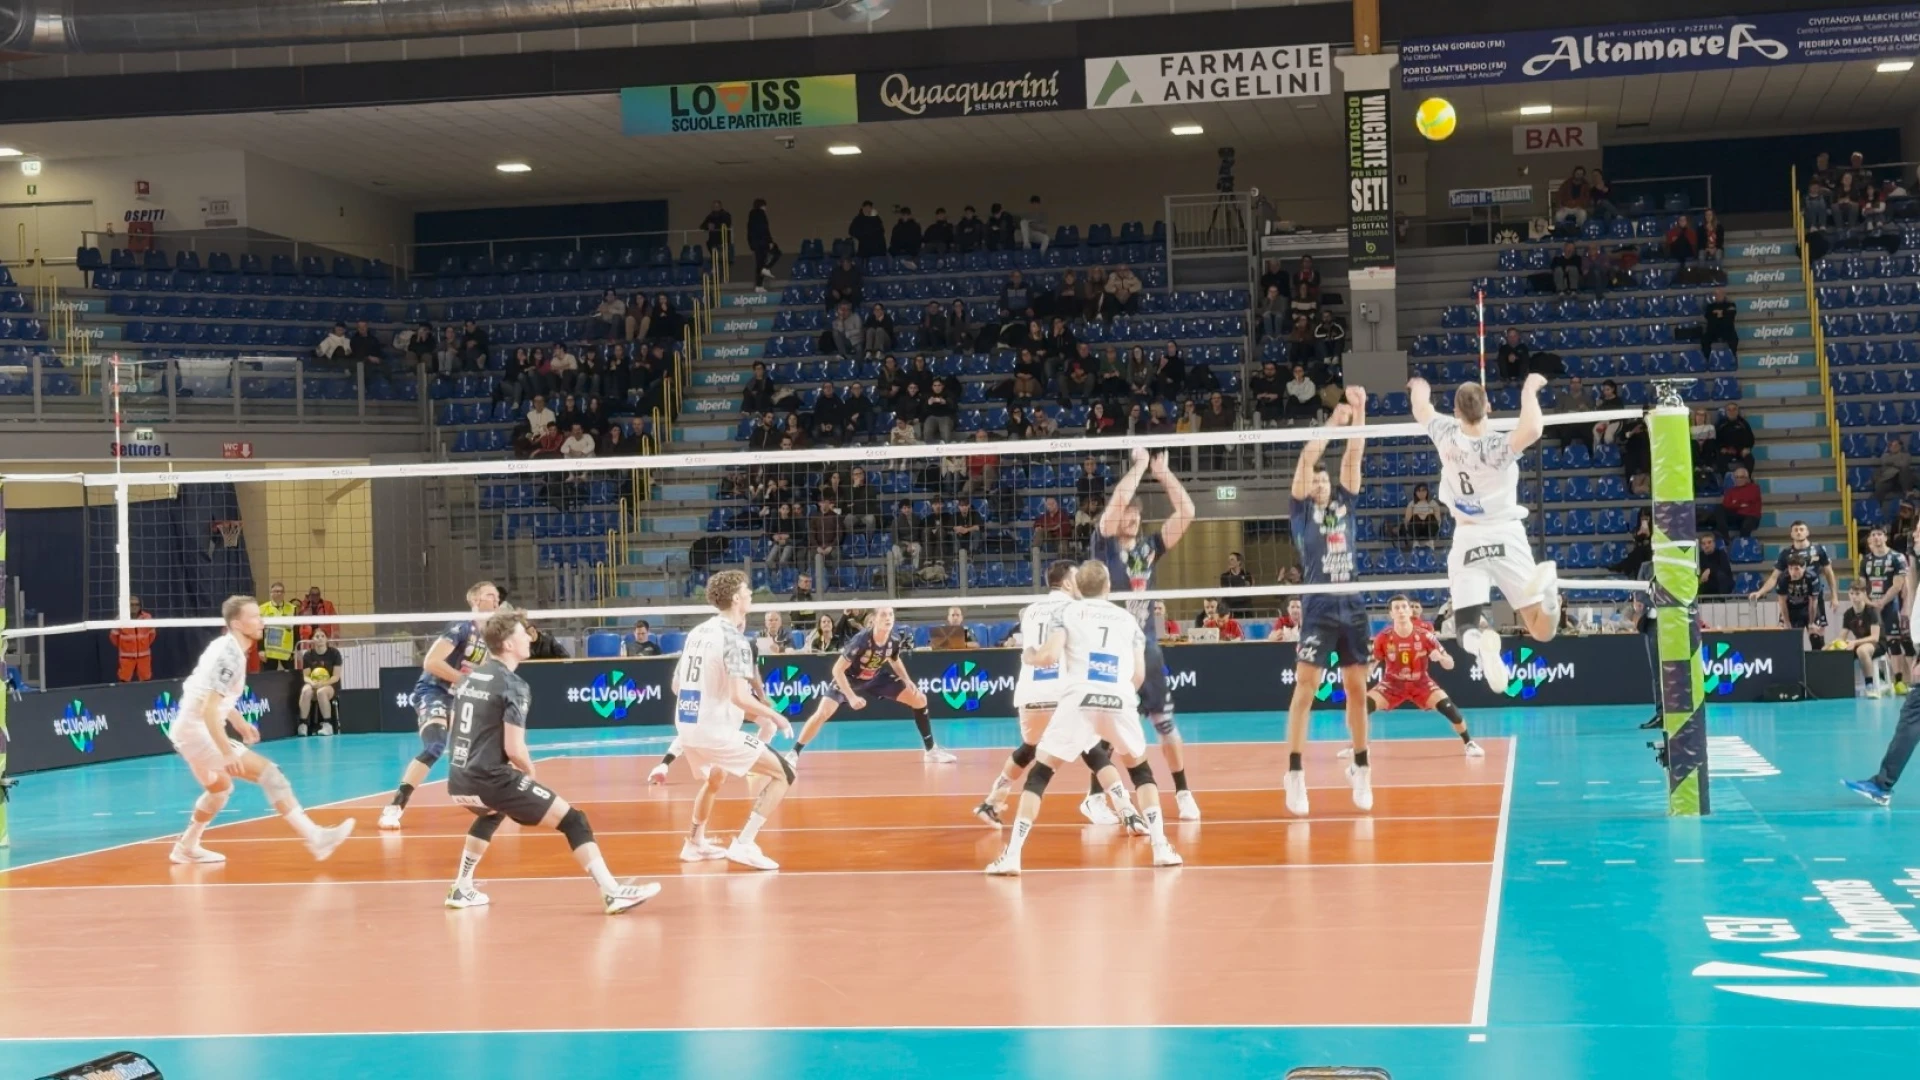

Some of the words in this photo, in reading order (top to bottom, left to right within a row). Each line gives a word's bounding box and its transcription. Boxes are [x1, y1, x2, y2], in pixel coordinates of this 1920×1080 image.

[1809, 16, 1860, 26] CIVITANOVA
[1863, 13, 1899, 22] MARCHE
[1598, 31, 1614, 39] BAR
[1622, 27, 1676, 37] RISTORANTE
[1684, 23, 1723, 33] PIZZERIA
[1403, 45, 1431, 54] PORTO
[1432, 43, 1448, 52] SAN
[1450, 41, 1486, 50] GIORGIO
[1487, 40, 1505, 49] (FM)
[1798, 39, 1840, 49] PIEDIRIPA
[1842, 38, 1852, 46] DI
[1853, 35, 1900, 45] MACERATA
[1160, 47, 1323, 77] FARMACIE
[1403, 66, 1431, 75] PORTO
[1488, 61, 1507, 71] (FM)
[880, 70, 1059, 115] Quacquarini
[1164, 72, 1319, 101] ANGELINI
[974, 99, 1058, 111] SERRAPETRONA
[672, 115, 725, 132] SCUOLE
[728, 111, 802, 129] PARITARIE
[1348, 96, 1362, 168] ATTACCO
[1362, 95, 1388, 168] VINCENTE
[1525, 127, 1584, 150] BAR
[1351, 177, 1388, 213] SET!
[124, 208, 165, 222] OSPITI
[1352, 222, 1388, 230] DIGITALI
[1743, 243, 1781, 258] alperia
[1746, 270, 1785, 285] alperia
[733, 294, 767, 307] alperia
[1750, 297, 1789, 312] alperia
[724, 320, 757, 333] alperia
[1754, 324, 1794, 339] alperia
[714, 346, 749, 359] alperia
[1758, 353, 1799, 368] alperia
[705, 372, 740, 385] alperia
[696, 399, 731, 413] alperia
[110, 442, 162, 457] Settore
[164, 442, 171, 456] L
[223, 443, 238, 451] WC
[1458, 471, 1474, 495] 6
[1098, 626, 1109, 648] 7
[1401, 651, 1409, 665] 6
[685, 655, 702, 683] 15
[1470, 662, 1574, 683] #VolleyM
[1702, 658, 1773, 679] VolleyM
[918, 676, 1015, 695] #CLVolleyM
[567, 685, 661, 704] #CLVolleyM
[54, 714, 108, 736] #CLVolleyM
[459, 702, 474, 734] 9
[532, 785, 551, 800] 9
[1703, 916, 1801, 942] CEV
